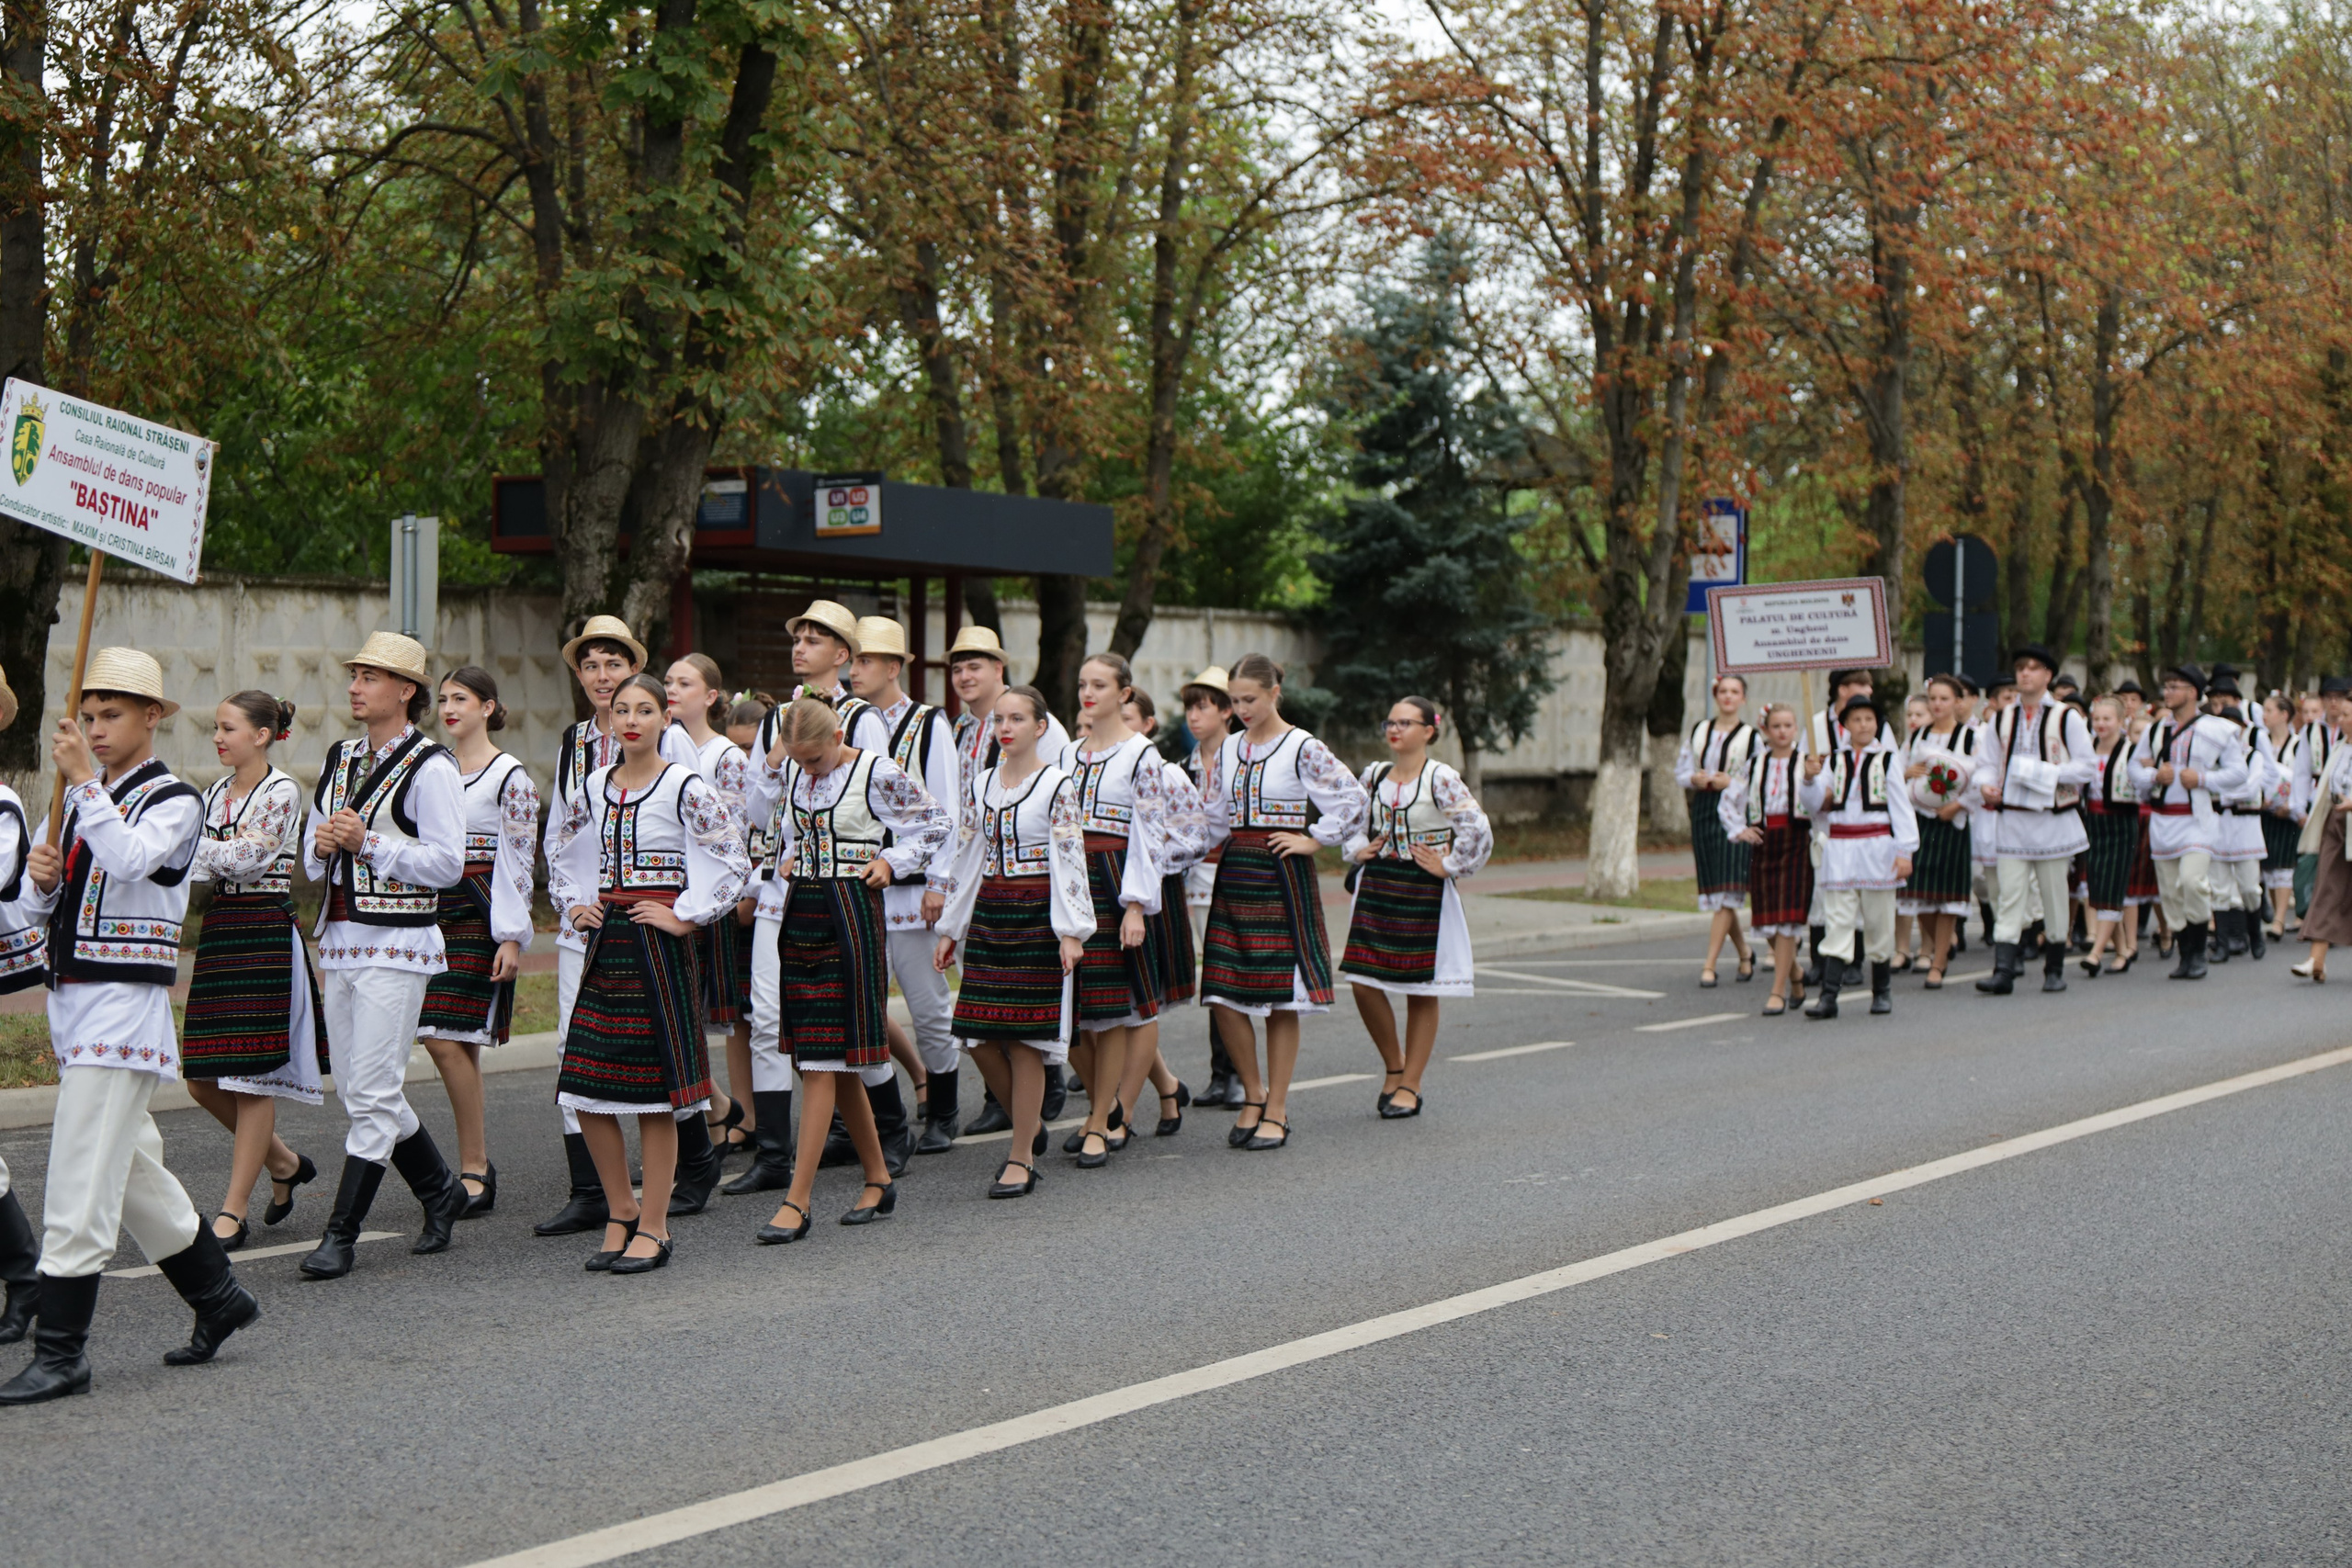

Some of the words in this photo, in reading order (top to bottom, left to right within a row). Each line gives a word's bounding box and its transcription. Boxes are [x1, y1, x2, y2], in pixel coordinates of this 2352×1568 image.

[59, 400, 103, 425] CONSILIUL
[106, 416, 143, 439] RAIONAL
[145, 428, 190, 455] STRĂȘENI
[75, 429, 93, 446] Casa
[94, 434, 126, 456] Raională
[127, 446, 137, 459] de
[138, 449, 166, 469] Cultură
[48, 444, 103, 477] Ansamblul
[104, 464, 117, 481] de
[119, 468, 144, 491] dans
[145, 479, 187, 506] popular
[0, 493, 40, 518] Conducător
[41, 510, 69, 530] artistic:
[72, 520, 99, 540] MAXIM
[98, 531, 107, 546] și
[107, 533, 144, 560] CRISTINA
[70, 480, 159, 531] "BAȘTINA"
[1739, 613, 1786, 625] PALATUL
[1790, 612, 1805, 621] DE
[1808, 609, 1858, 620] CULTURĂ
[1786, 624, 1828, 635] Ungheni
[1753, 637, 1806, 648] Ansamblul
[1810, 636, 1821, 644] de
[1825, 634, 1849, 643] dans
